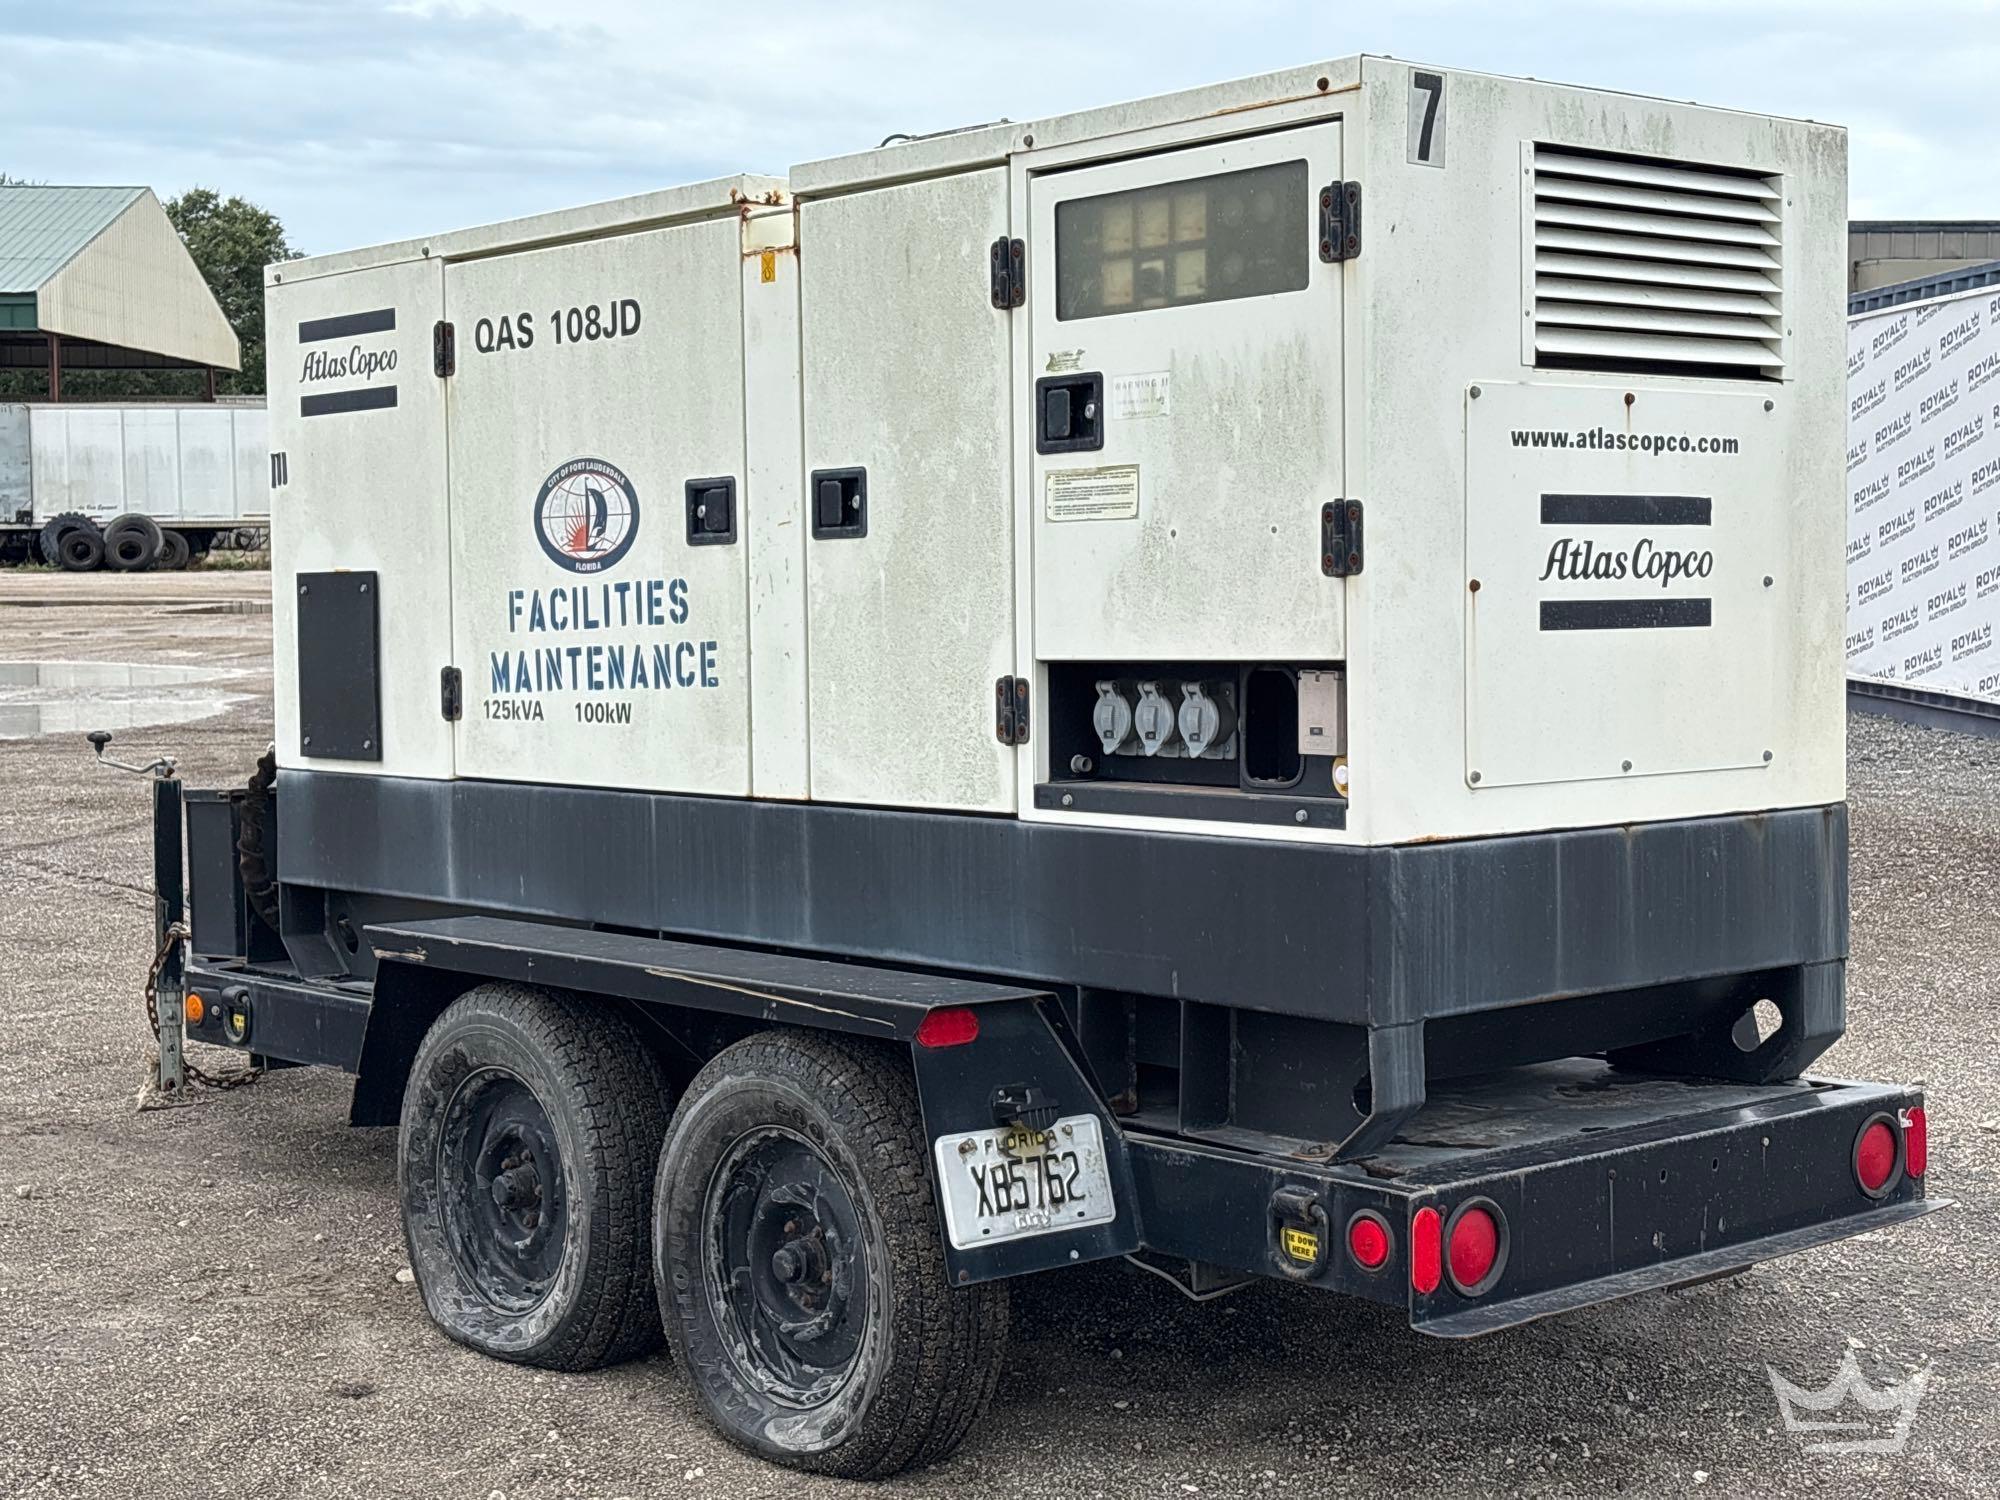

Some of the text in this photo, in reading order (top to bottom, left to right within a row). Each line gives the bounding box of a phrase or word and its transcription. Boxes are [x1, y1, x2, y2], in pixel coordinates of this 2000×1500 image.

[1413, 71, 1443, 162] 7
[474, 298, 641, 354] QAS 108JD
[1873, 322, 1901, 351] ROYAL
[1940, 320, 1971, 351] ROYAL
[299, 344, 398, 383] Atlas Copco
[1894, 354, 1923, 383] ROYAL
[1968, 352, 2000, 383] ROYAL
[1851, 386, 1878, 414] ROYAL
[1920, 386, 1950, 415] ROYAL
[1510, 426, 1739, 456] www.atlascopco.com
[1875, 417, 1904, 444] ROYAL
[1944, 421, 1975, 451] ROYAL
[547, 461, 625, 488] CITY OF FORT LAUDERDALE
[1898, 452, 1927, 479] ROYAL
[1854, 479, 1882, 505] ROYAL
[1924, 486, 1954, 513] ROYAL
[1879, 513, 1907, 538] ROYAL
[1948, 524, 1979, 551] ROYAL
[575, 561, 602, 571] FLORIDA
[1538, 537, 1714, 588] Atlas Copco
[1902, 550, 1931, 575] ROYAL
[1858, 574, 1885, 597] ROYAL
[1976, 565, 2000, 589] ROYA
[508, 577, 689, 633] FACILITIES
[1928, 587, 1958, 612] ROYAL
[1882, 609, 1911, 633] ROYAL
[1846, 630, 1866, 649] OYAL
[1952, 628, 1983, 652] ROYAL
[490, 640, 719, 694] MAINTENANCE
[1904, 649, 1934, 672] ROYAL
[1979, 673, 2000, 693] ROY
[483, 699, 632, 724] 125kVA 100kW
[984, 1129, 1058, 1155] FLORIDA
[970, 1150, 1087, 1218] XB5762
[1292, 1244, 1311, 1257] HERE
